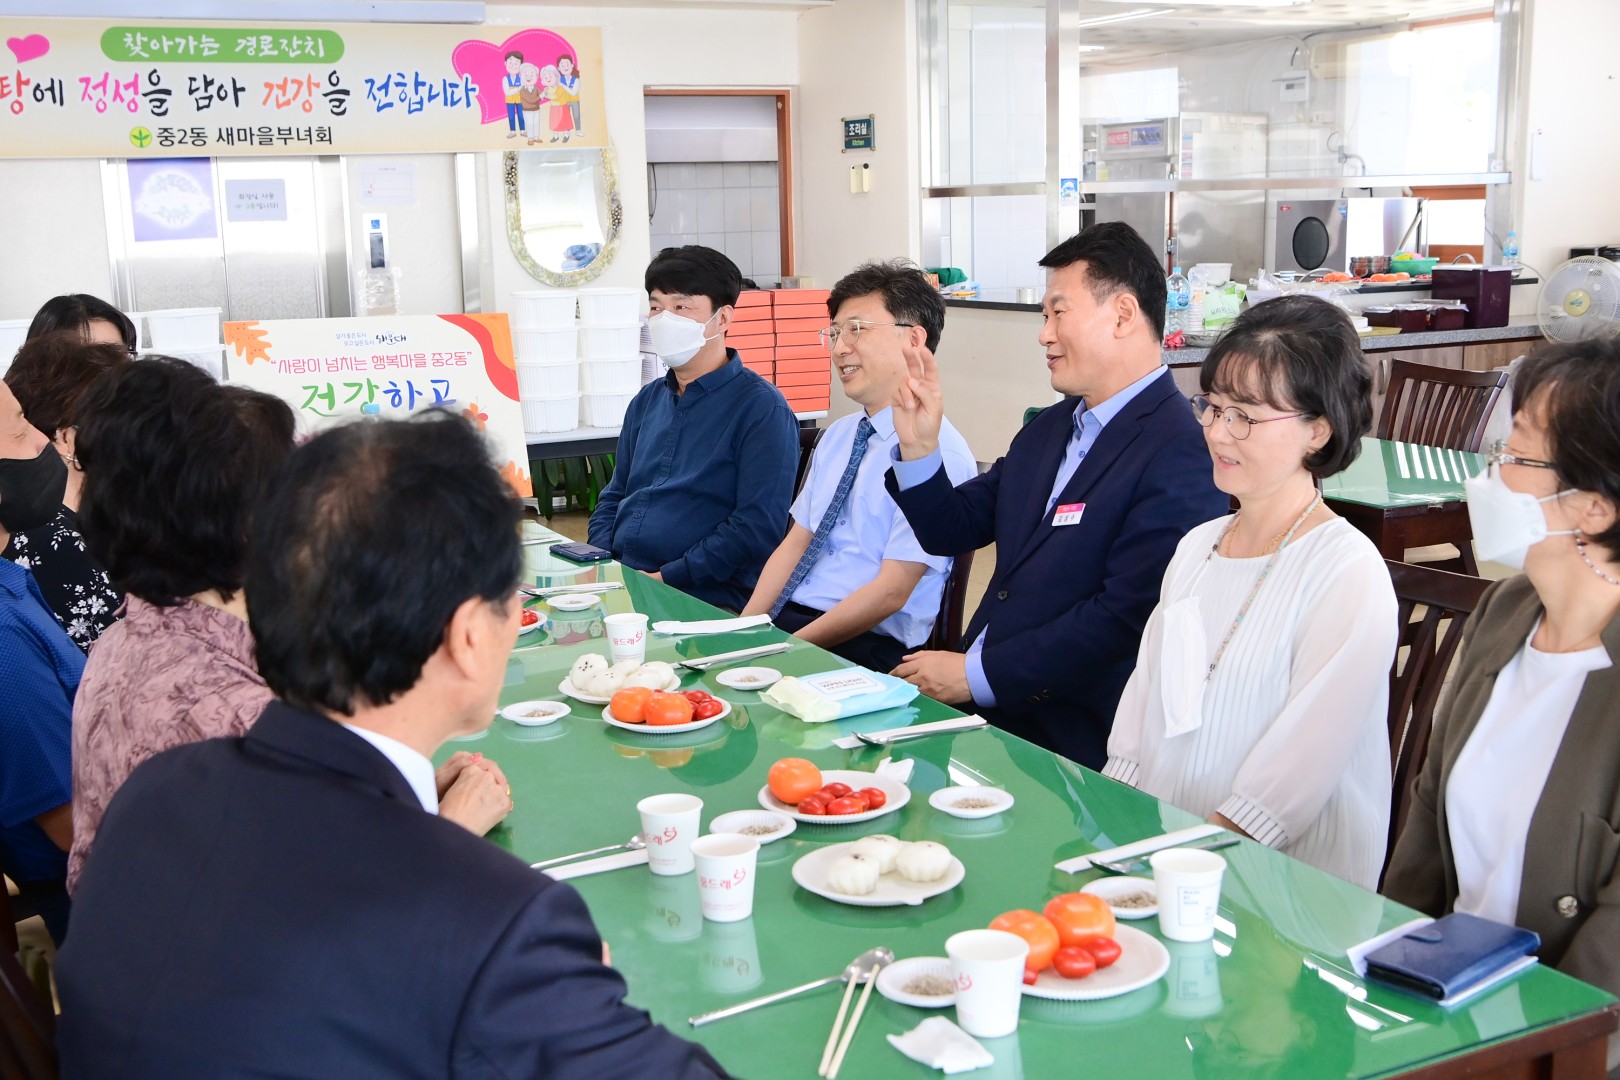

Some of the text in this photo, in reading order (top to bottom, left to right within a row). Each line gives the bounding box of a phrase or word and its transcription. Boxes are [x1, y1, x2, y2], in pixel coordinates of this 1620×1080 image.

[123, 31, 325, 58] 찾아가는 경로잔치
[78, 68, 173, 117] 정성을
[187, 73, 246, 112] 담아
[262, 70, 351, 116] 건강을
[364, 71, 477, 115] 전합니다
[156, 125, 333, 147] 중2동 새마을부녀회
[849, 122, 867, 136] 조리실
[325, 356, 368, 373] 넘치는
[371, 352, 427, 370] 행복마을
[300, 377, 457, 417] 건강하고
